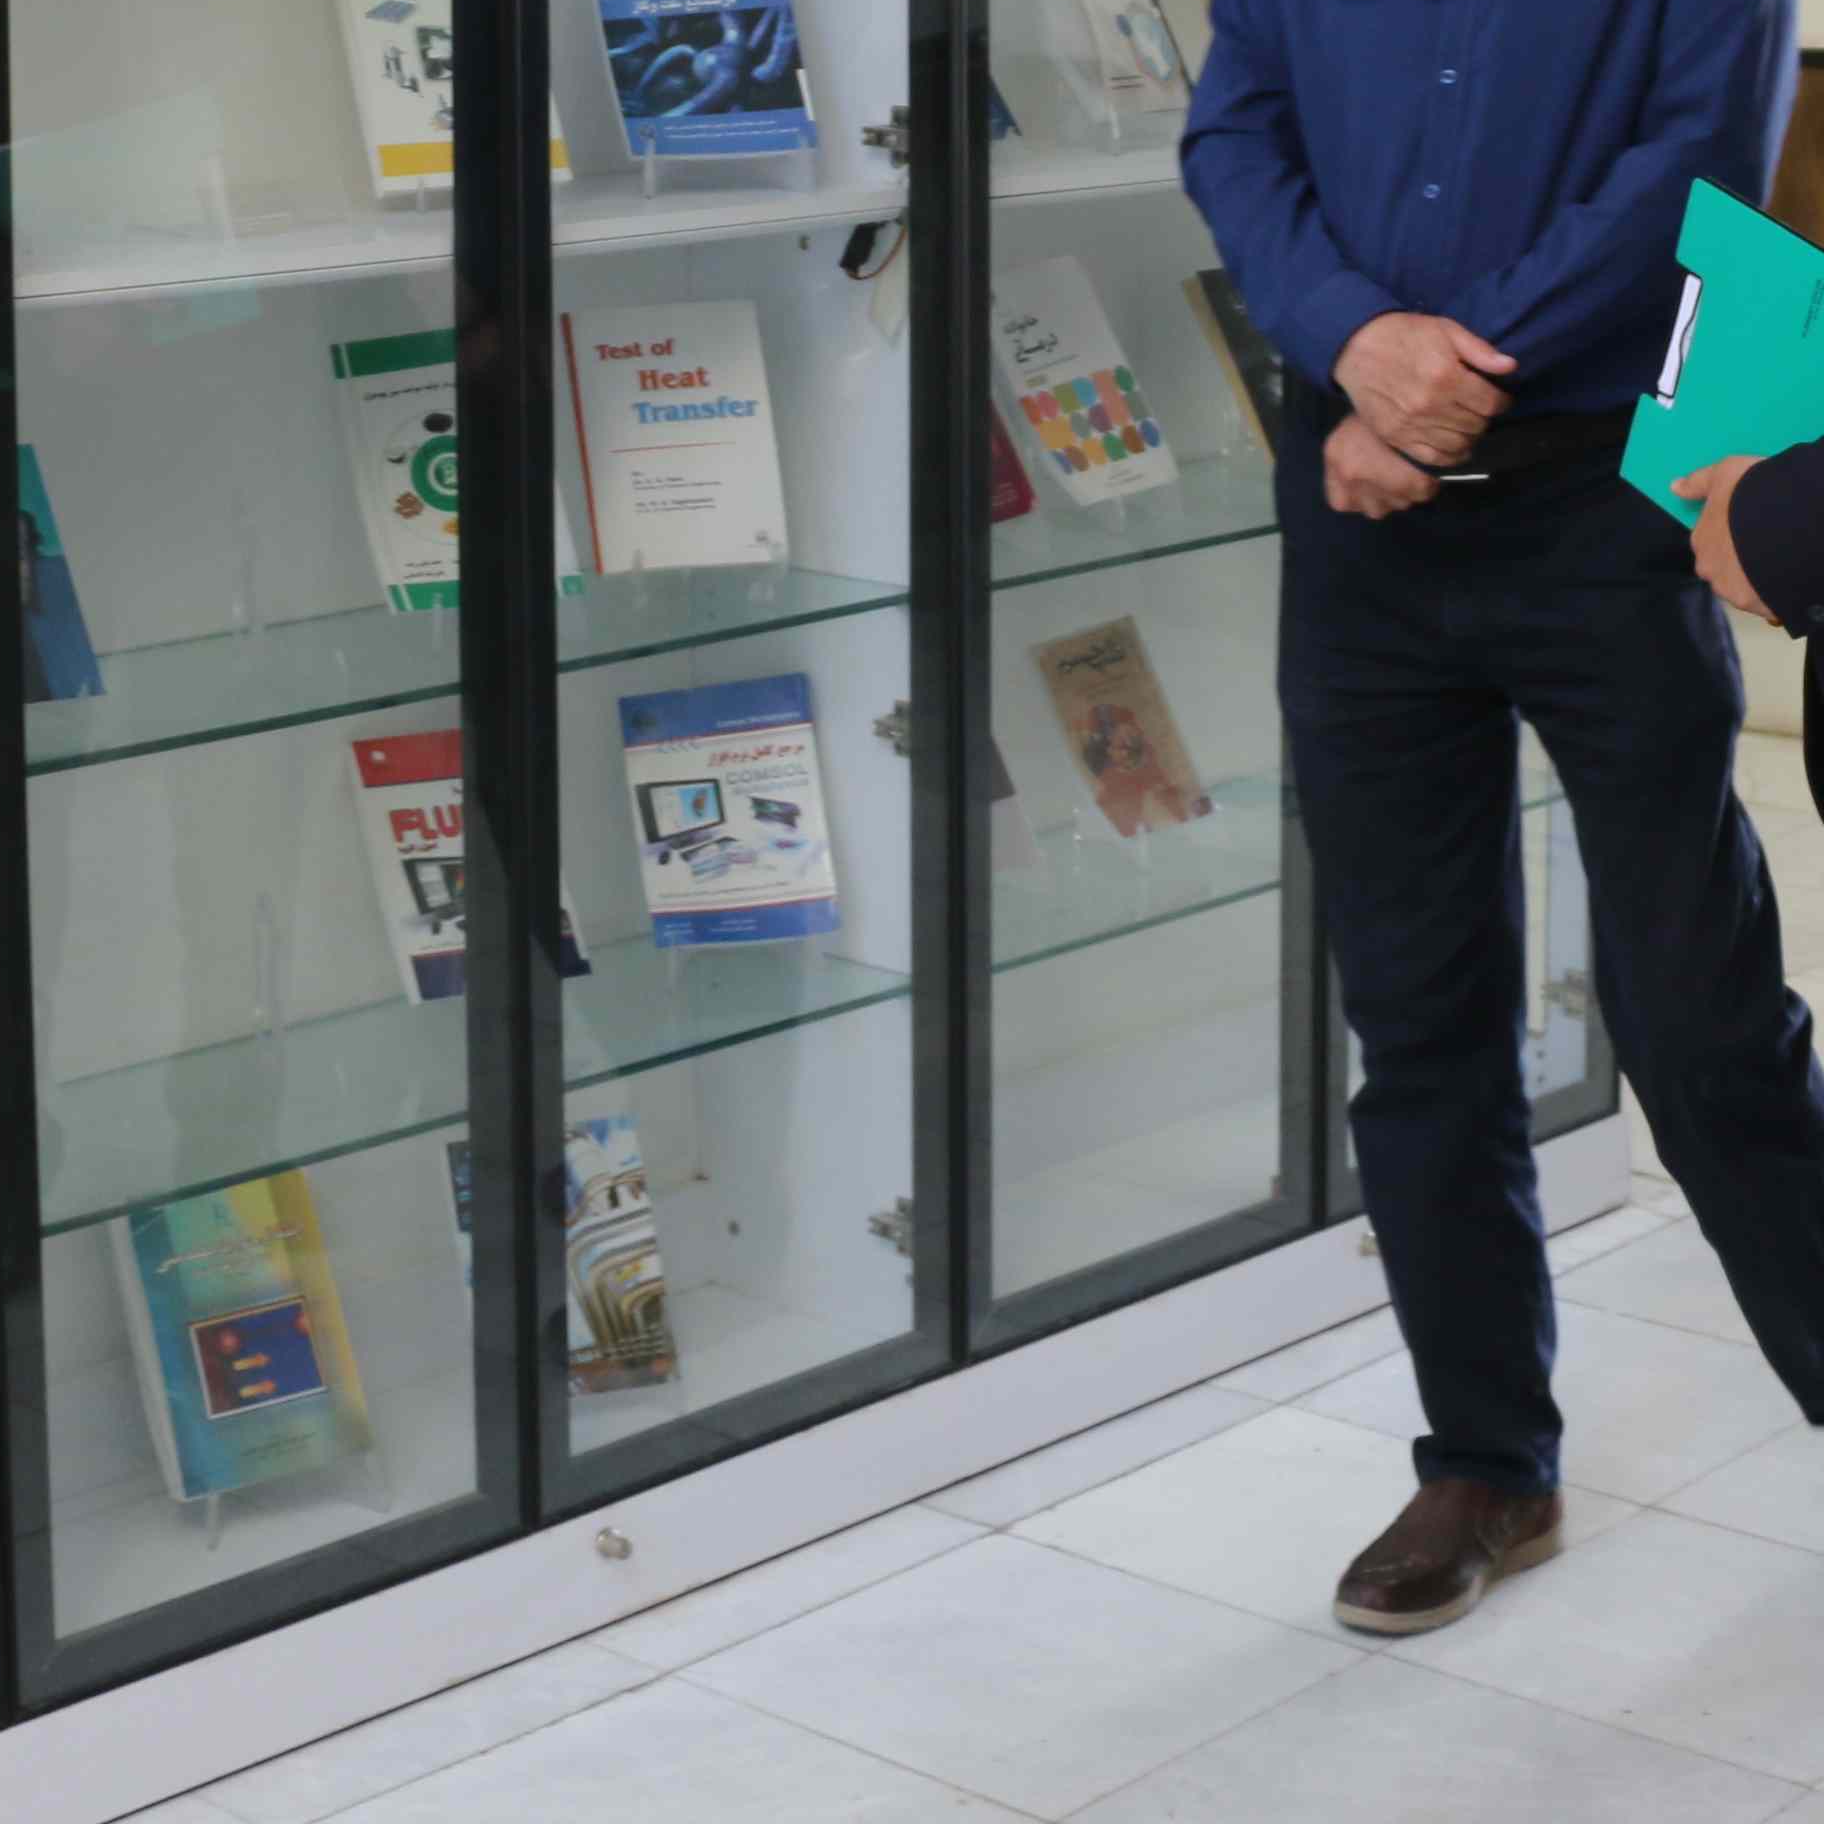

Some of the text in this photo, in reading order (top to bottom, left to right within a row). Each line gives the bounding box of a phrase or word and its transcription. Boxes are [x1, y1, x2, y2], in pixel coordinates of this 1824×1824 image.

[593, 337, 675, 362] Test of
[637, 366, 711, 392] Heat
[632, 395, 760, 424] Transfer
[725, 764, 809, 785] COMSOL
[389, 804, 465, 843] FLU
